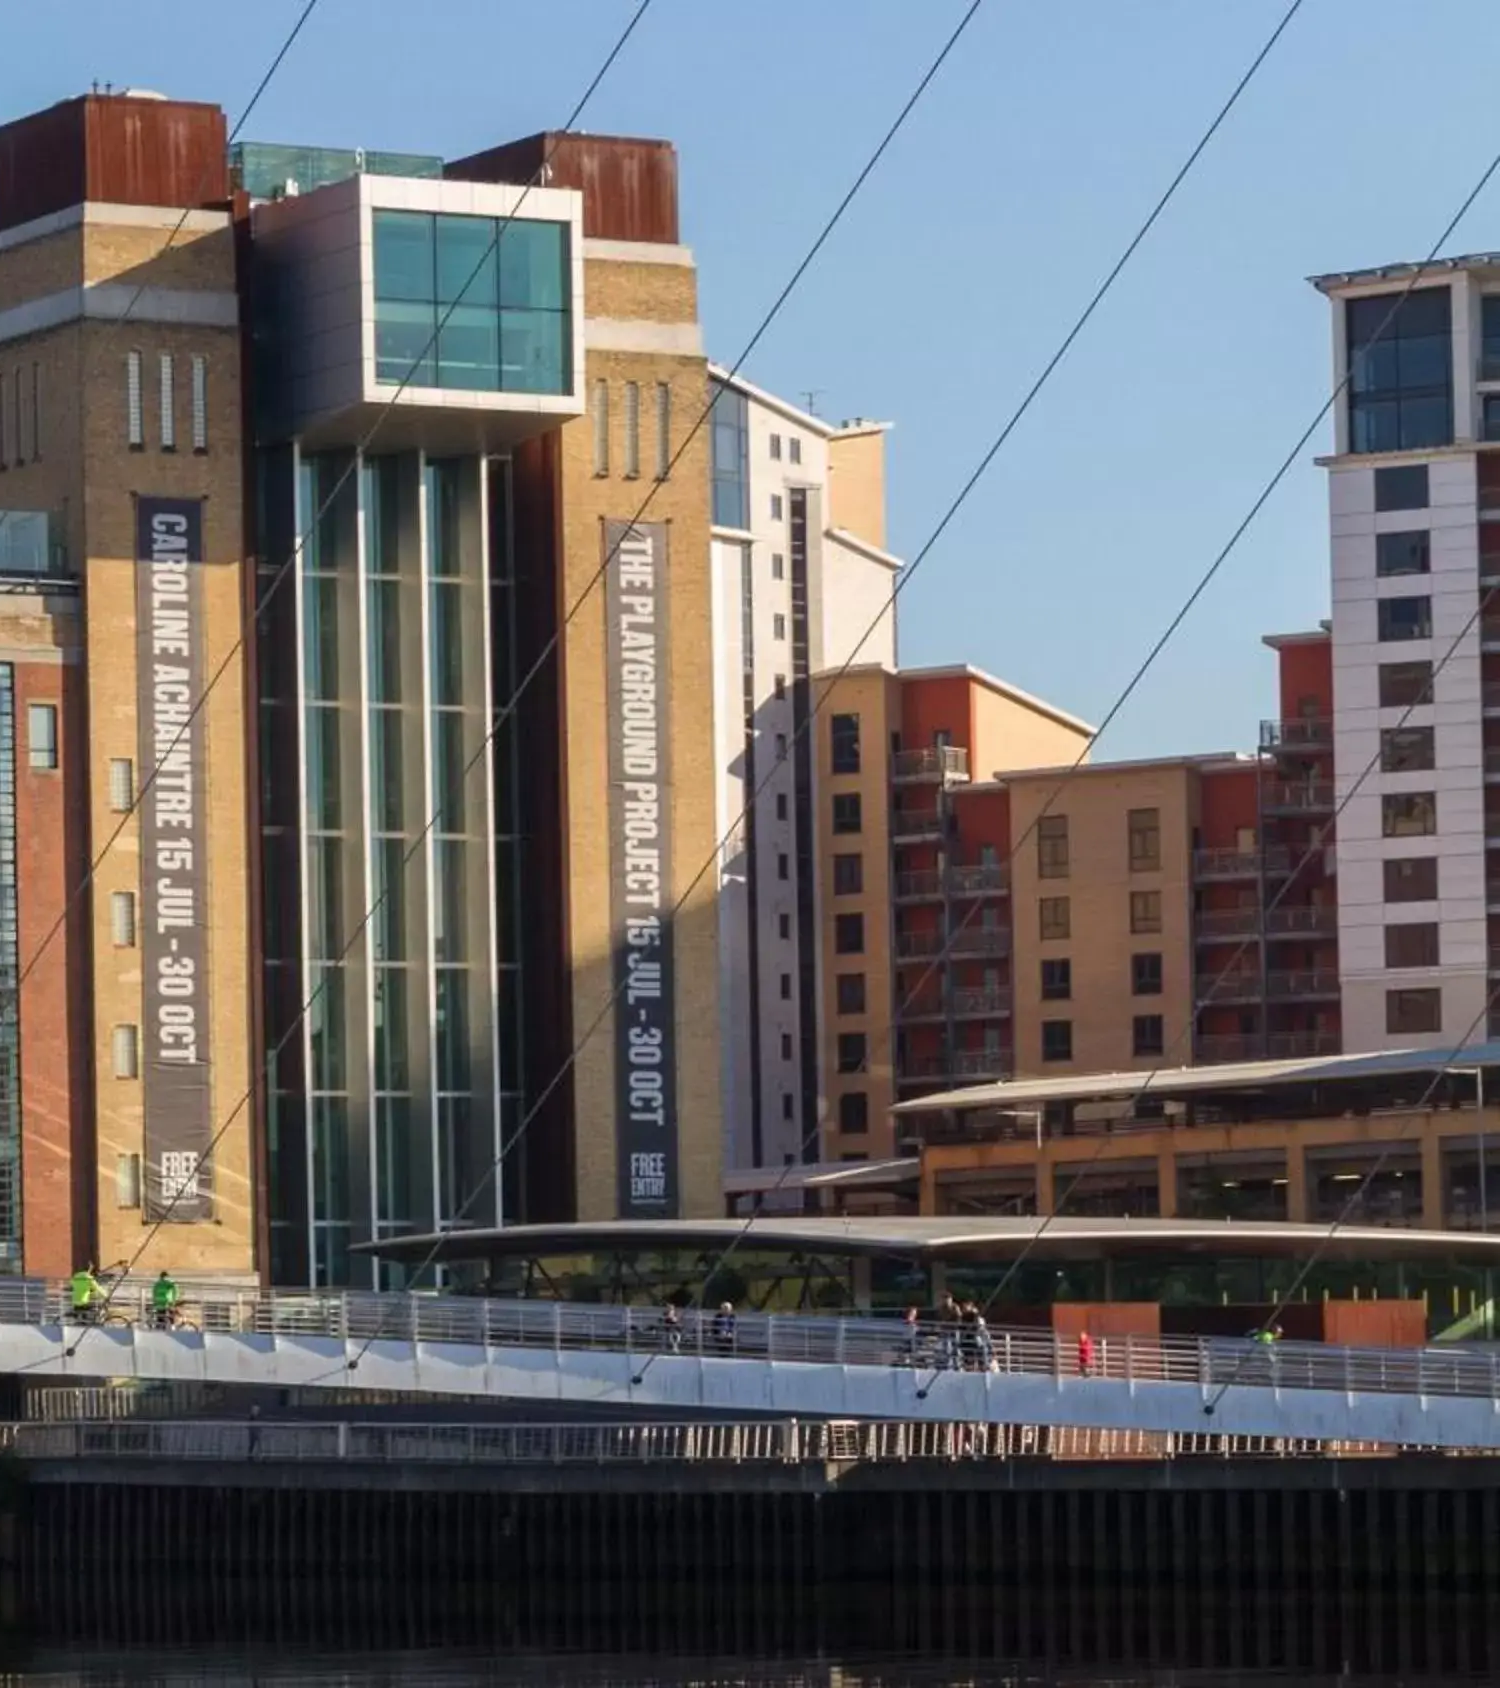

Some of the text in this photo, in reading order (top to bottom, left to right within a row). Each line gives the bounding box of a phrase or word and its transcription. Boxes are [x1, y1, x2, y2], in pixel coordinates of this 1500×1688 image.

[152, 513, 189, 657] CAROLINE
[619, 537, 653, 588] THE
[620, 595, 657, 775] PLAYGROUND
[153, 663, 193, 829] ACHAINTRE
[156, 838, 193, 871] 15
[625, 782, 659, 908] PROJECT
[157, 878, 194, 934] JUL
[626, 916, 660, 945] 15
[158, 957, 195, 996] 30
[628, 953, 661, 1005] JUL
[159, 1004, 196, 1064] OCT
[629, 1027, 662, 1064] 30
[629, 1071, 663, 1126] OCT
[630, 1153, 666, 1176] FREE
[630, 1178, 665, 1197] ENTRY
